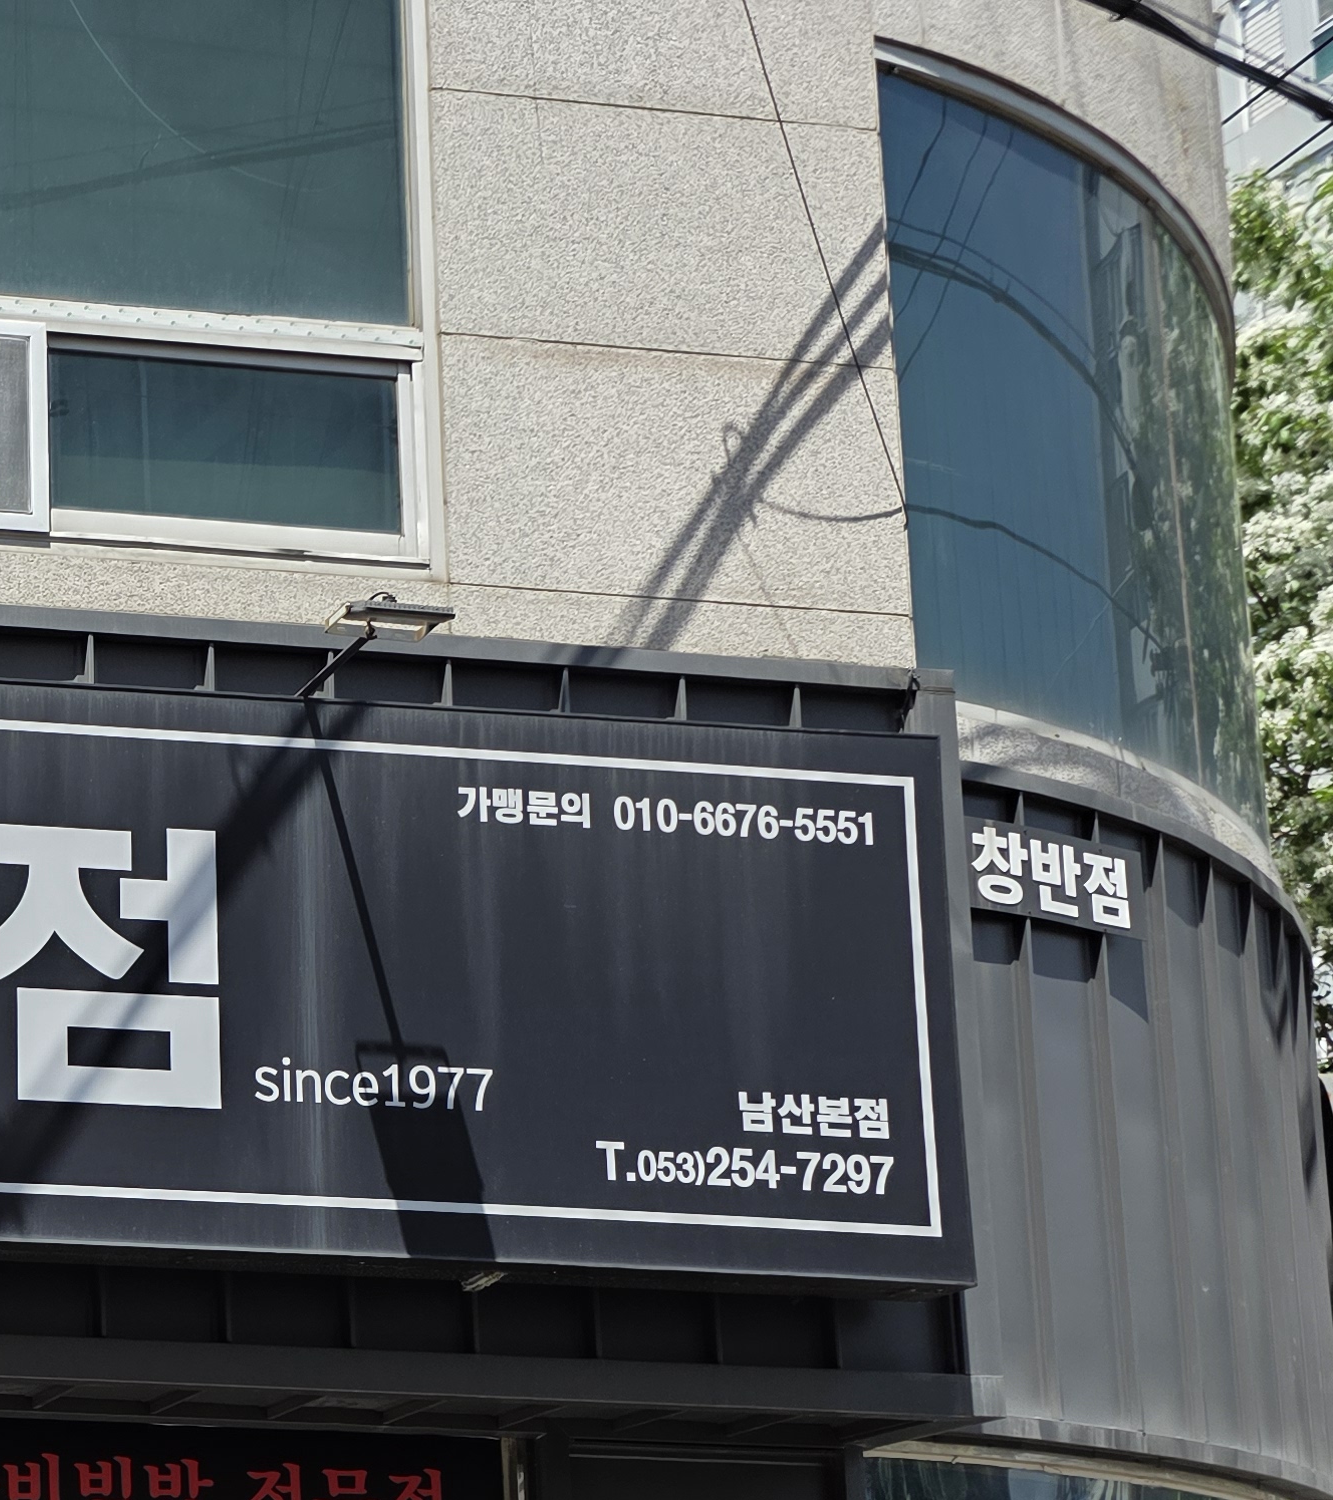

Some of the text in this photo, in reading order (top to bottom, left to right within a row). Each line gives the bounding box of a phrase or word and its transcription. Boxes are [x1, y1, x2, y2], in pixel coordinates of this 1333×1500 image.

[456, 784, 875, 847] 가맹문의 010-6676-5551
[253, 1058, 494, 1113] since1977
[737, 1090, 891, 1140] 남산본점
